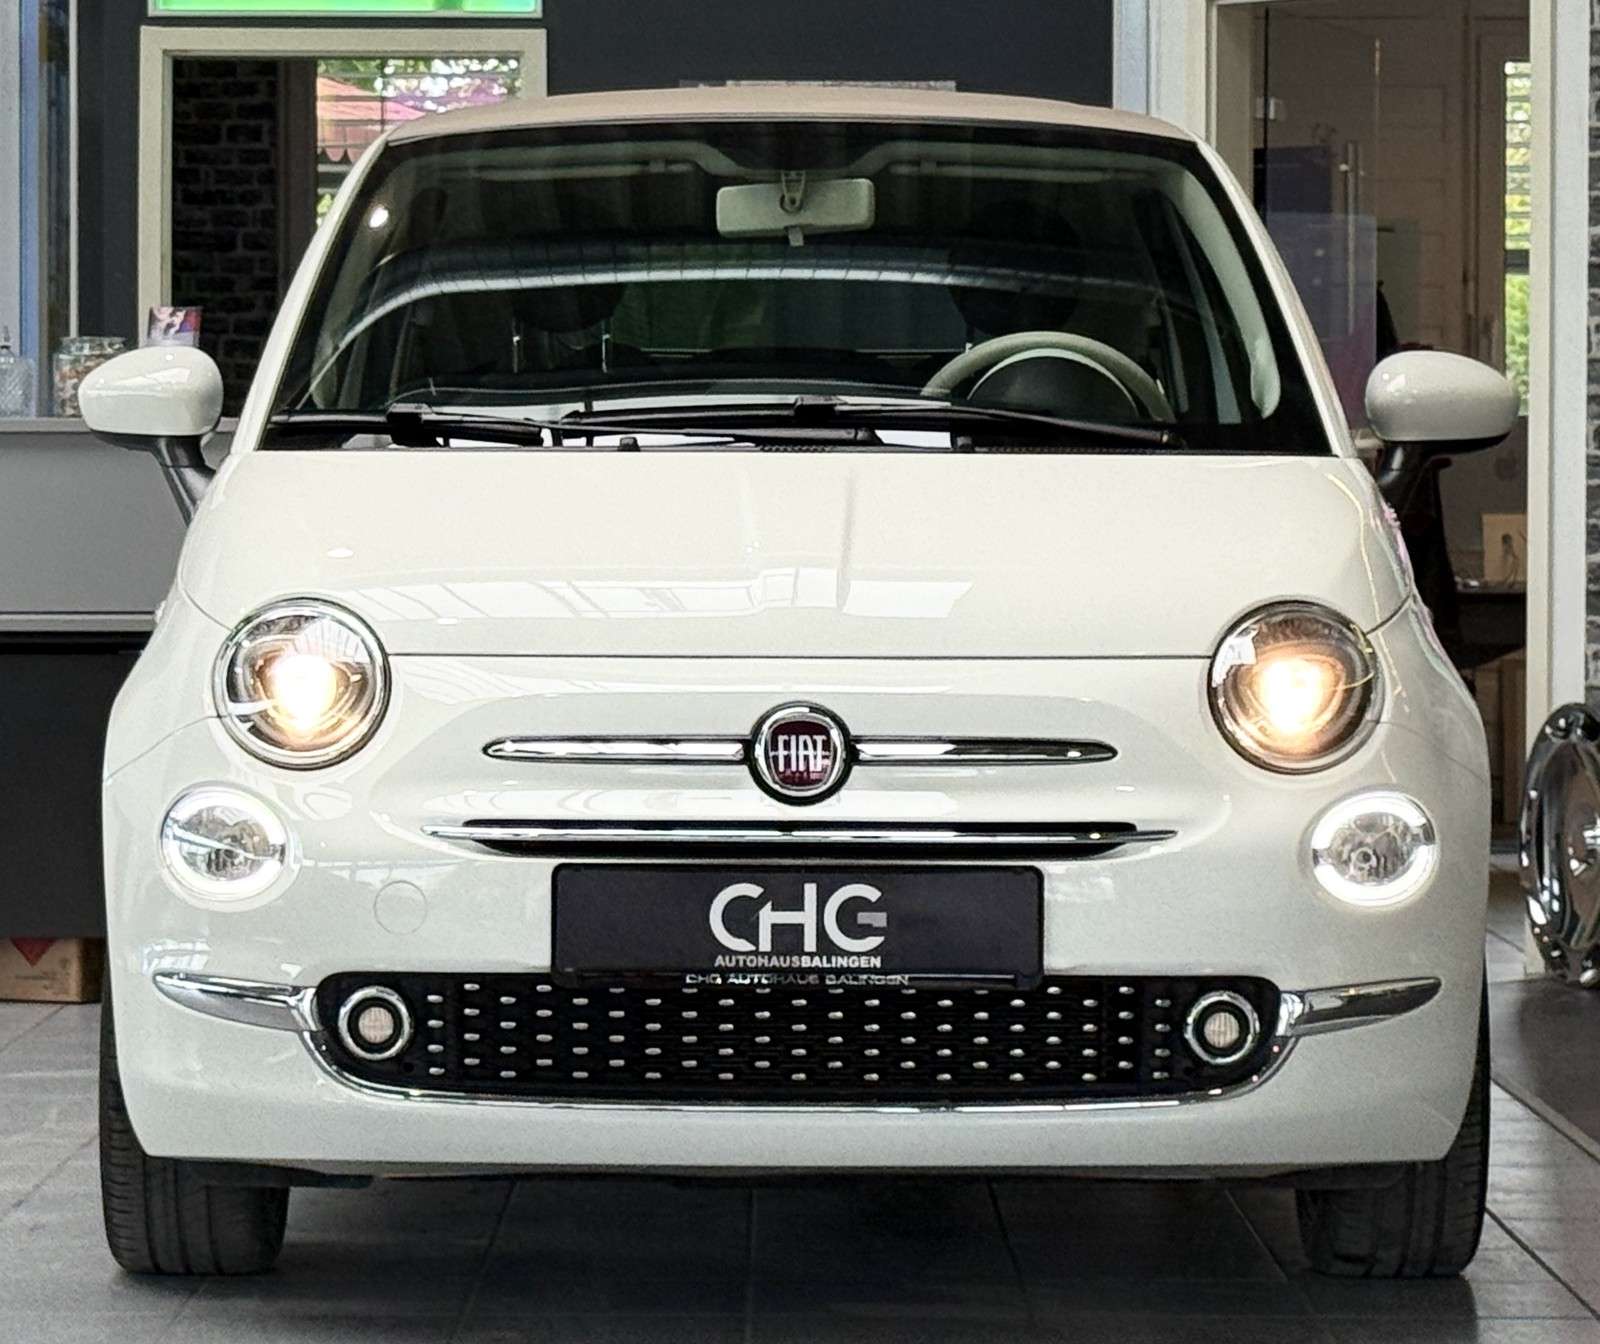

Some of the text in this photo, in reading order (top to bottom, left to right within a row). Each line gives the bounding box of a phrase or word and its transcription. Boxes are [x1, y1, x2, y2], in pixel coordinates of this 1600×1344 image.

[778, 734, 827, 772] FIAT
[709, 882, 888, 952] CHG
[727, 973, 820, 984] AUTOHAUS
[825, 973, 909, 985] BALINGEN
